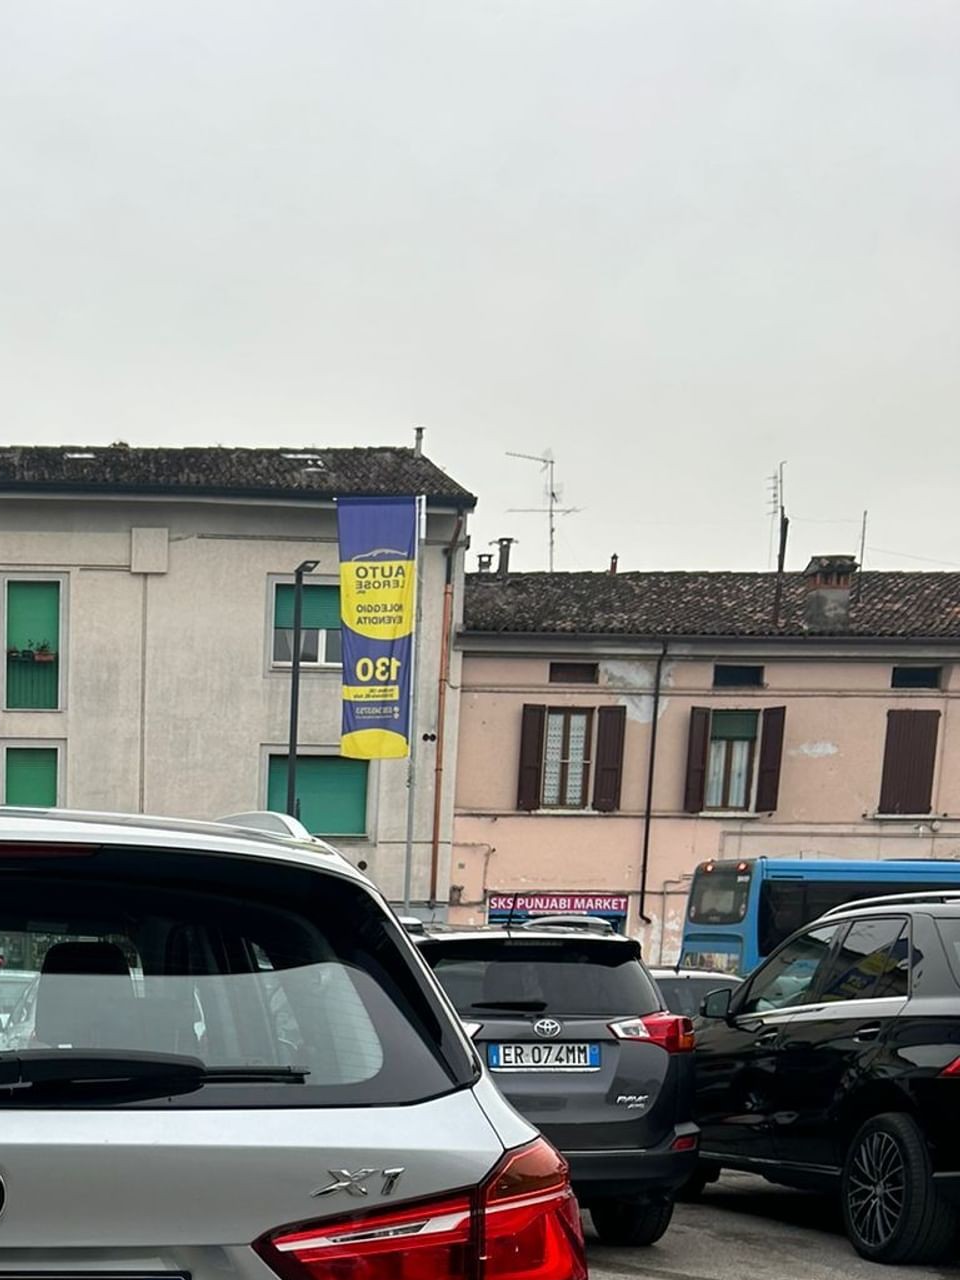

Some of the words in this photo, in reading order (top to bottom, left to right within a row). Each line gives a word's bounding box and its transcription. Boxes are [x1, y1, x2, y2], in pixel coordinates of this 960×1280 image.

[490, 898, 514, 909] SKS
[516, 898, 571, 910] PUNJABI
[573, 898, 627, 910] MARKET
[502, 1046, 524, 1064] ER
[531, 1046, 588, 1064] 074MM
[310, 1167, 405, 1198] X1
